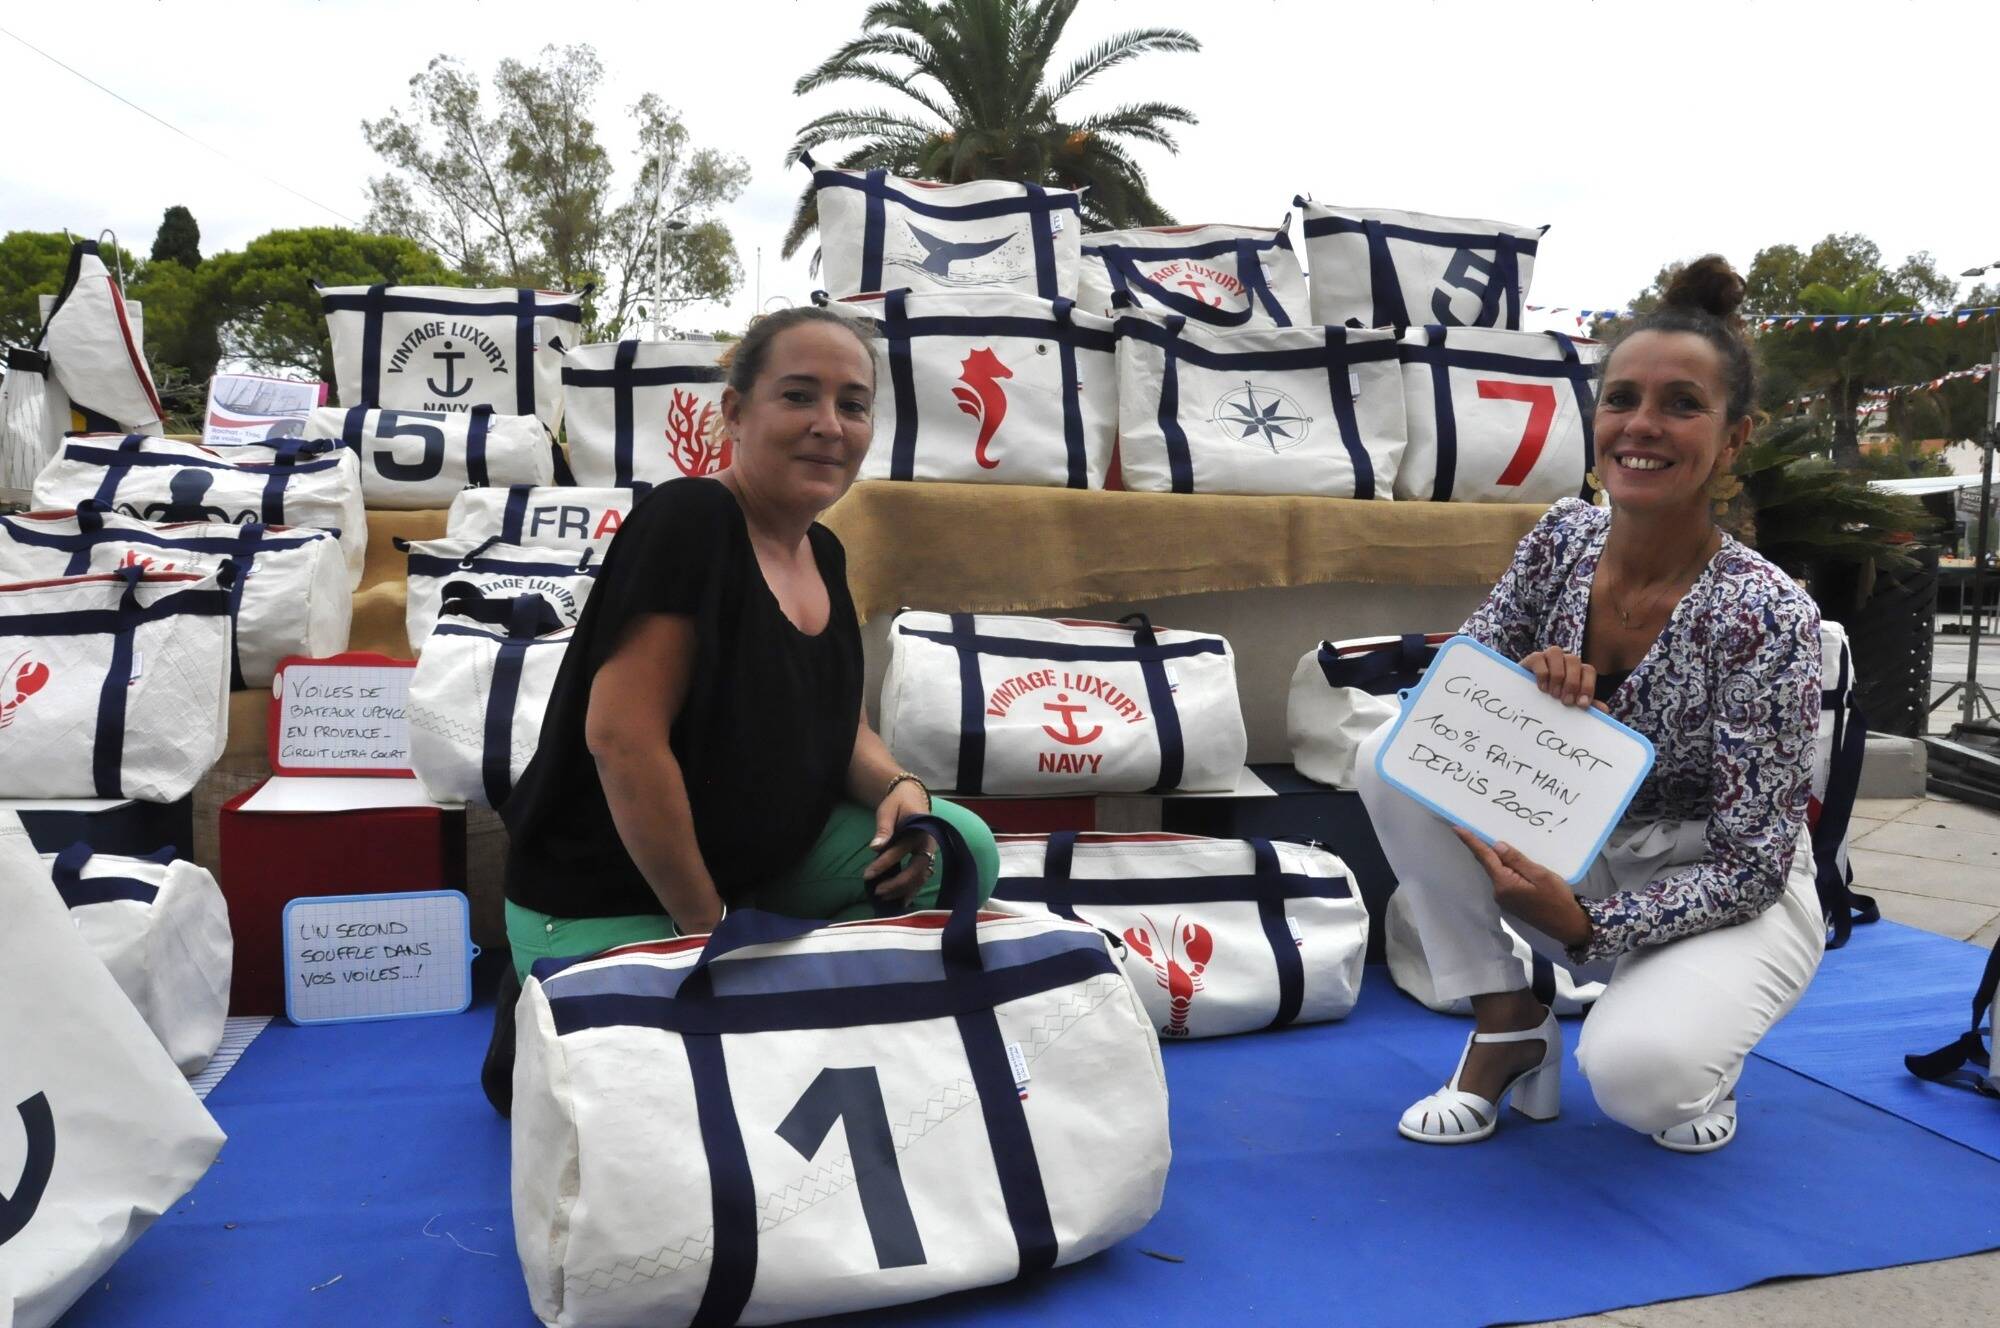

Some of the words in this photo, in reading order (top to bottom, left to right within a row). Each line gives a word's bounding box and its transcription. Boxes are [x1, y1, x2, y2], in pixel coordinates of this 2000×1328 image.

[1146, 263, 1183, 287] TAGE
[1185, 261, 1247, 297] LUXURY
[387, 321, 446, 373] VINTAGE
[450, 322, 508, 374] LUXURY
[423, 402, 469, 413] NAVY
[373, 409, 447, 482] 5
[1476, 379, 1557, 486] 7
[530, 505, 624, 540] FRA
[480, 578, 524, 596] TAGE
[528, 578, 578, 622] LUXURY
[359, 687, 387, 699] DE
[986, 669, 1057, 718] VINTAGE
[1064, 673, 1148, 724] LUXURY
[290, 704, 356, 719] BATEAUX
[362, 705, 408, 720] UPCYCL
[286, 726, 307, 739] EN
[1413, 714, 1481, 753] 100%
[1536, 729, 1614, 771] COURT
[331, 748, 367, 759] ULTRA
[370, 749, 407, 760] COURT
[1038, 752, 1103, 774] NAVY
[335, 921, 409, 939] SECOND
[300, 945, 379, 964] SOUFFLE
[383, 941, 432, 959] DANS
[301, 971, 337, 988] VOS
[774, 1065, 928, 1270] 1
